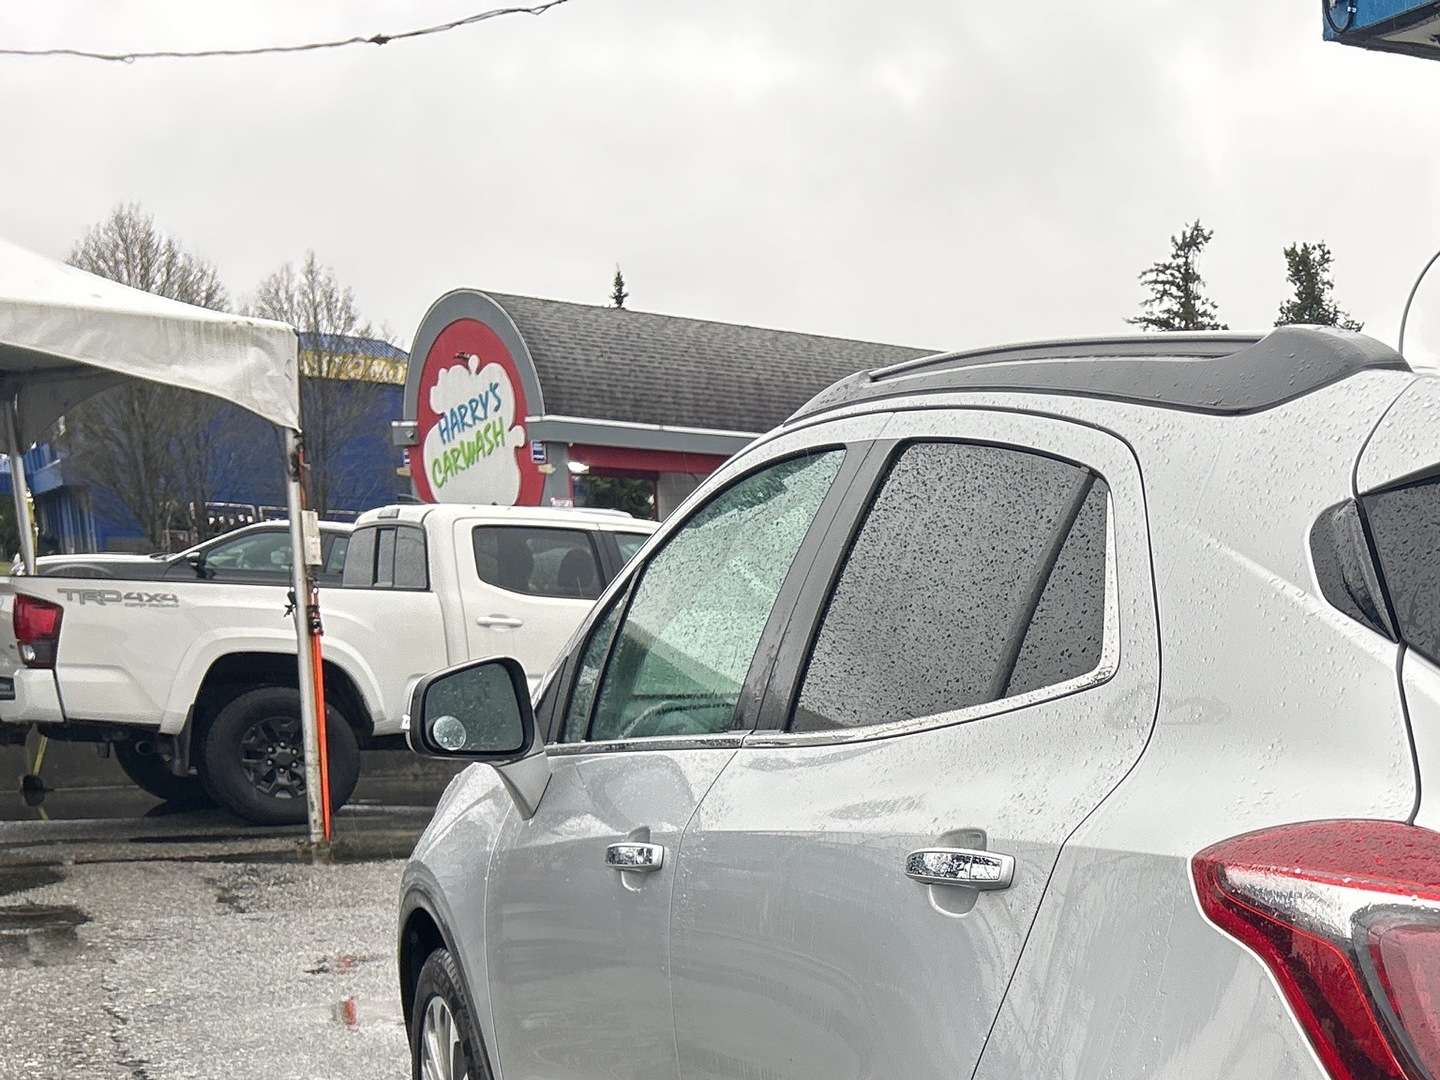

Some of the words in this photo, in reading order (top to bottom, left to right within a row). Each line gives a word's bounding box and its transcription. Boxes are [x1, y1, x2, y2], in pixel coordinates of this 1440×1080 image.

[438, 381, 502, 445] HARRY'S
[431, 417, 506, 489] CARWASH
[57, 588, 122, 606] TRD
